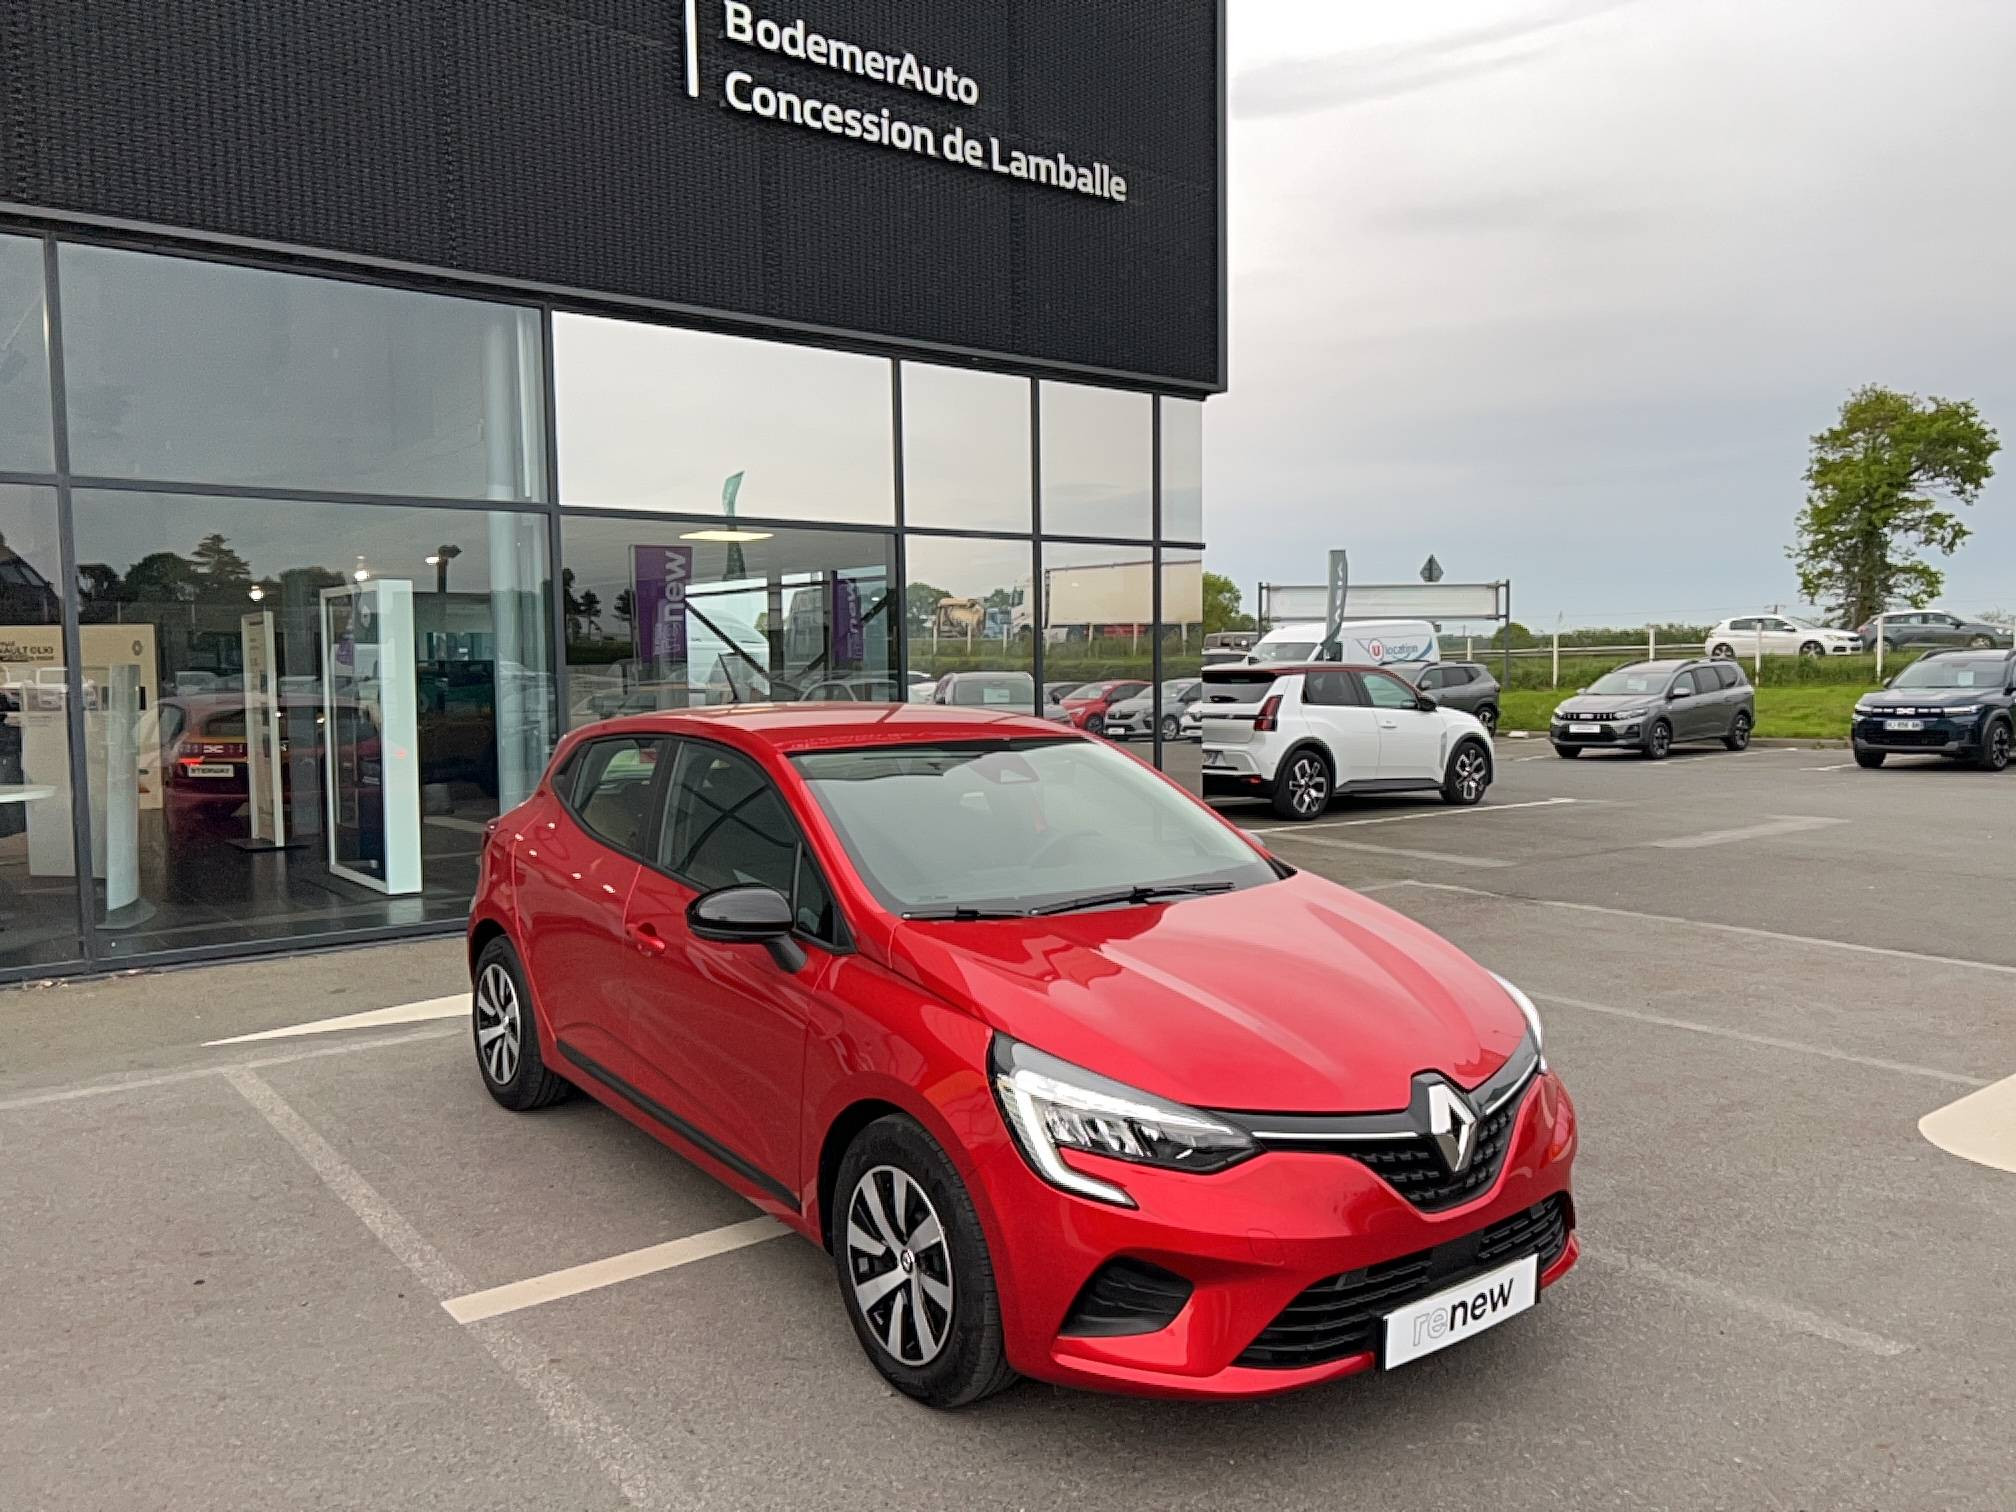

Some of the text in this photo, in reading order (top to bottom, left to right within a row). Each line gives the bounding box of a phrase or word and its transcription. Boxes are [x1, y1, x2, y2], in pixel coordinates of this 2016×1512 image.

[725, 0, 979, 105] BodemerAuto
[725, 70, 1128, 202] Concession de Lamballe
[1413, 1278, 1513, 1346] renew
